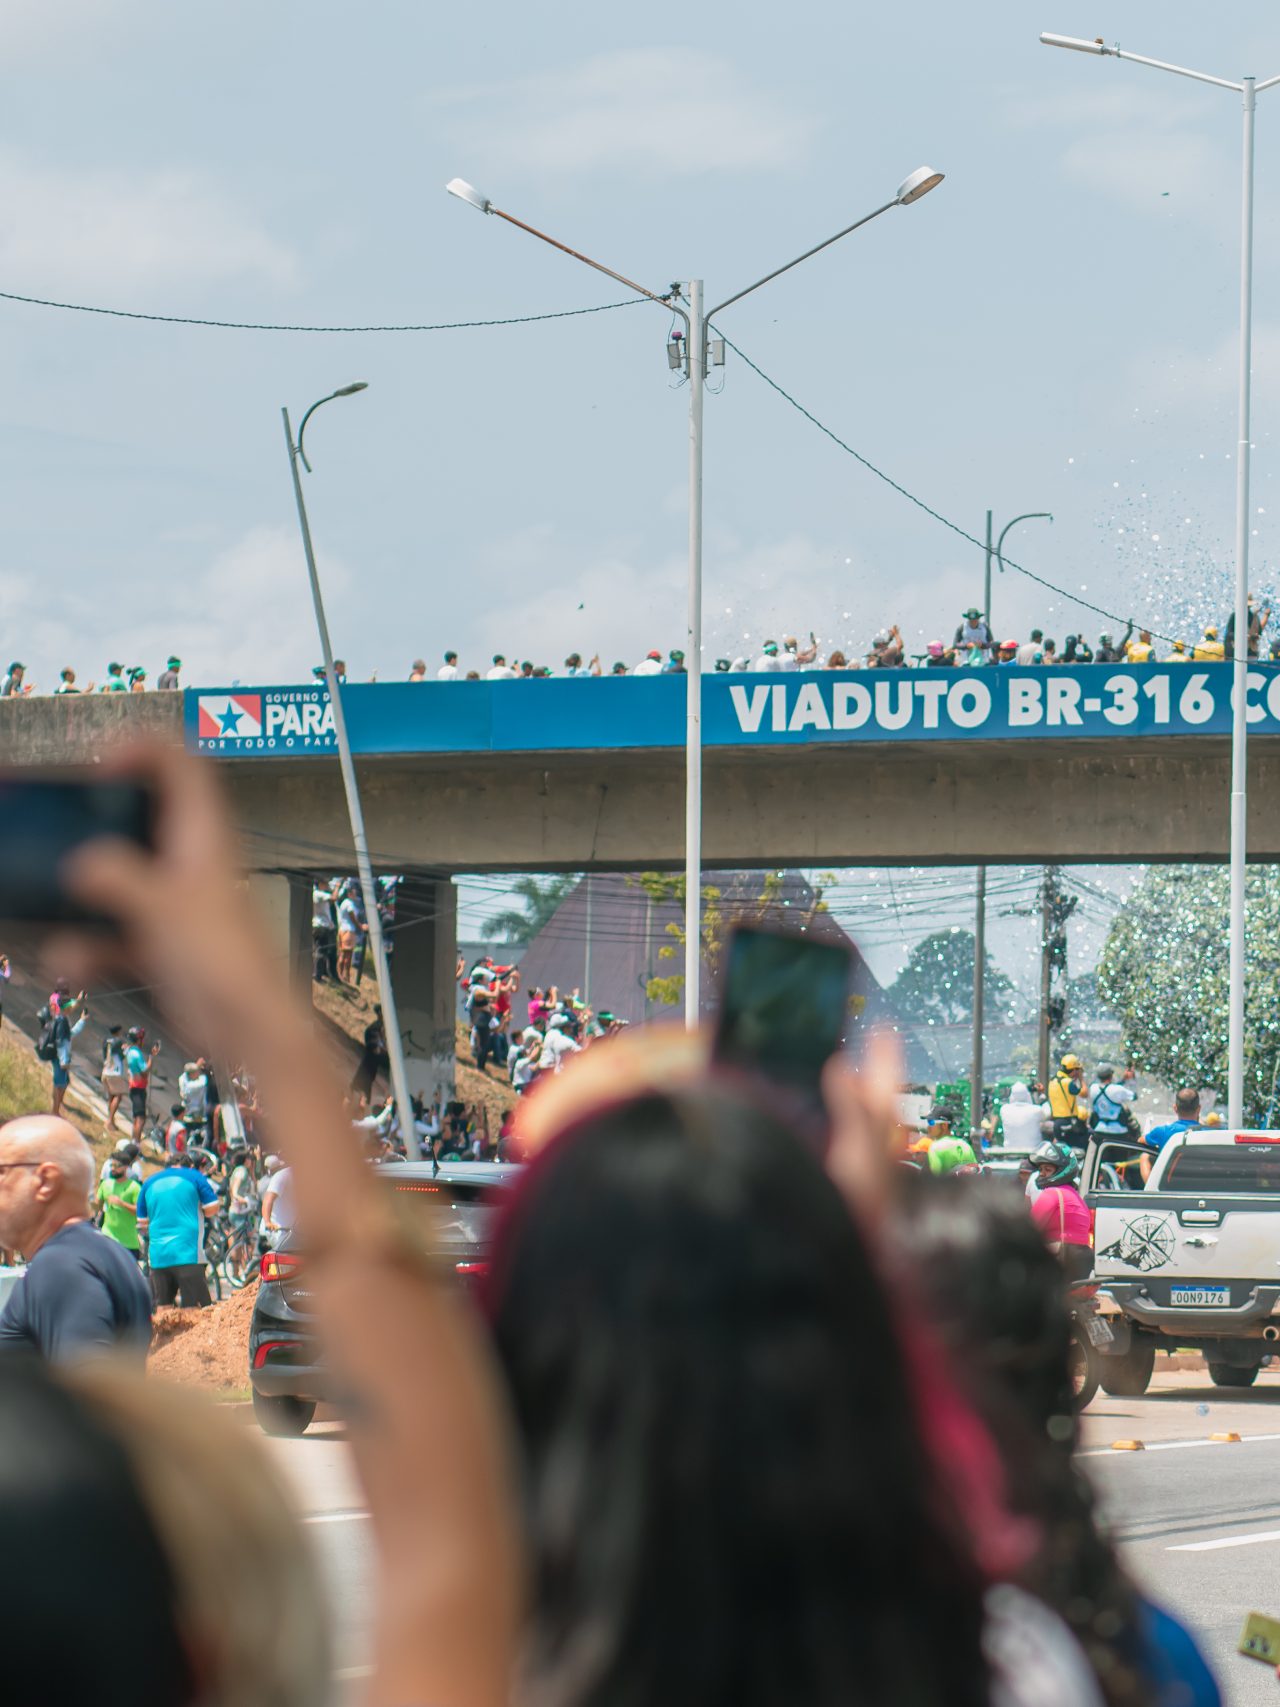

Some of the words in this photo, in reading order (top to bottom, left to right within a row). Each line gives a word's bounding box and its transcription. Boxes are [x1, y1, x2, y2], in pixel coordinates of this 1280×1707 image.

[265, 692, 318, 703] GOVERNO
[729, 679, 991, 733] VIADUTO
[1008, 674, 1215, 727] BR-316
[199, 739, 225, 750] POR
[236, 738, 276, 749] TODO
[286, 737, 294, 748] O
